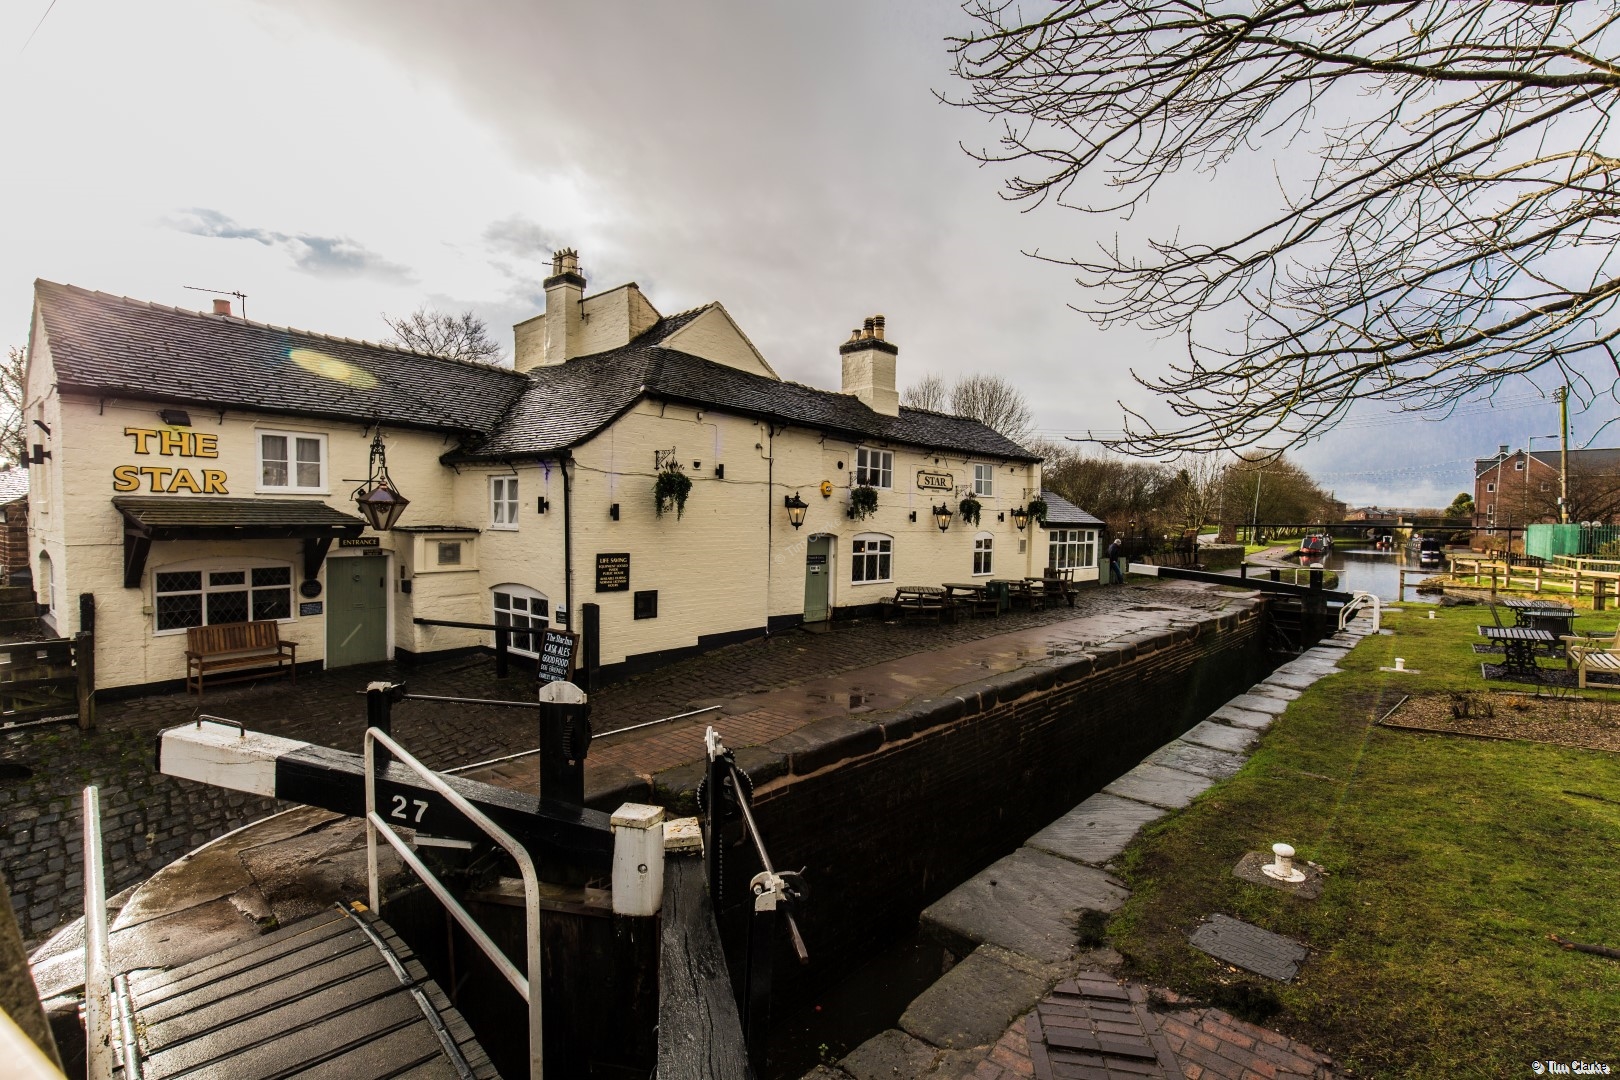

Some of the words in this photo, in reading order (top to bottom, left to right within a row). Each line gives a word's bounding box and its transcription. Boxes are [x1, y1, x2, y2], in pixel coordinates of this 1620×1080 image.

[124, 427, 219, 459] THE
[113, 465, 229, 494] STAR
[924, 475, 946, 487] STAR
[546, 632, 556, 642] The
[544, 643, 558, 654] CASK
[557, 646, 571, 657] ALES
[541, 654, 555, 664] GOOD
[555, 657, 569, 667] FOOD
[391, 795, 429, 823] 27
